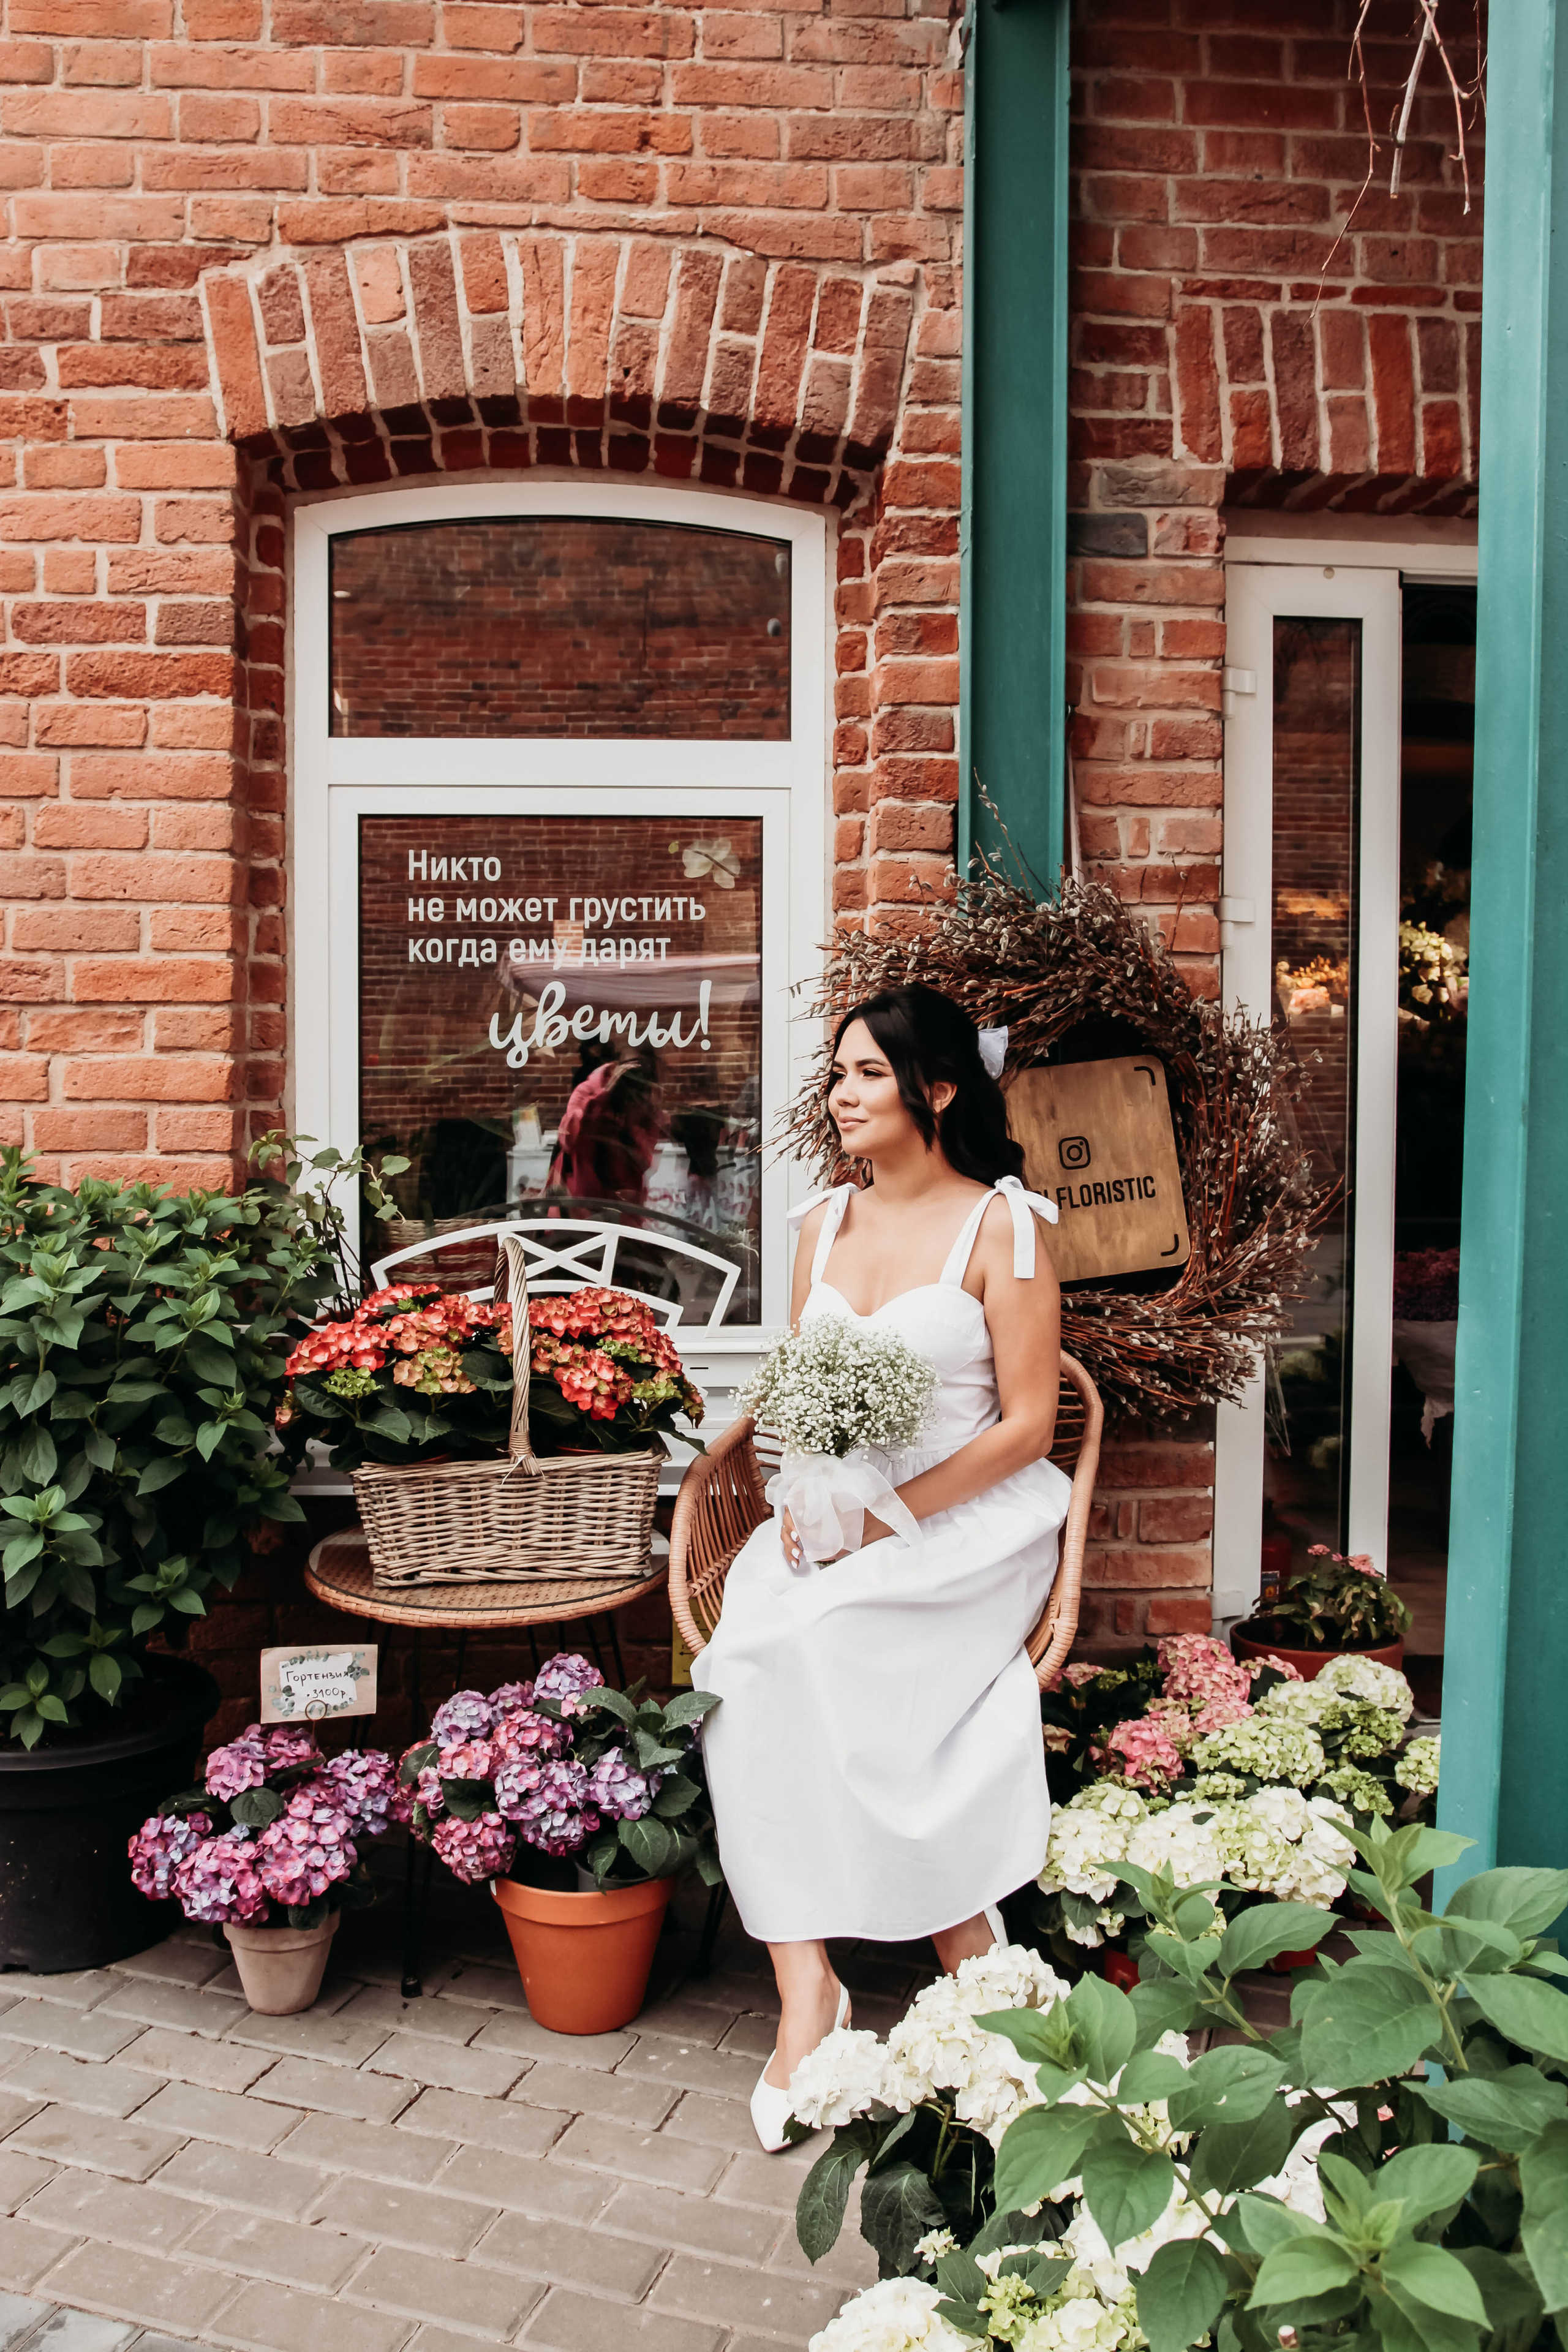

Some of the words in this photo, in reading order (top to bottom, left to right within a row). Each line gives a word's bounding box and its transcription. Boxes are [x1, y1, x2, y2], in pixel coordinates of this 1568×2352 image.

[409, 849, 501, 881] Никто
[409, 897, 444, 922] не
[457, 897, 558, 922] может
[570, 897, 706, 929] грустить
[409, 938, 497, 967] когда
[509, 938, 568, 970] ему
[580, 937, 671, 970] дарят
[489, 979, 712, 1069] цветы!
[1055, 1175, 1156, 1210] FLORISTIC
[286, 1670, 349, 1687] Гортензия
